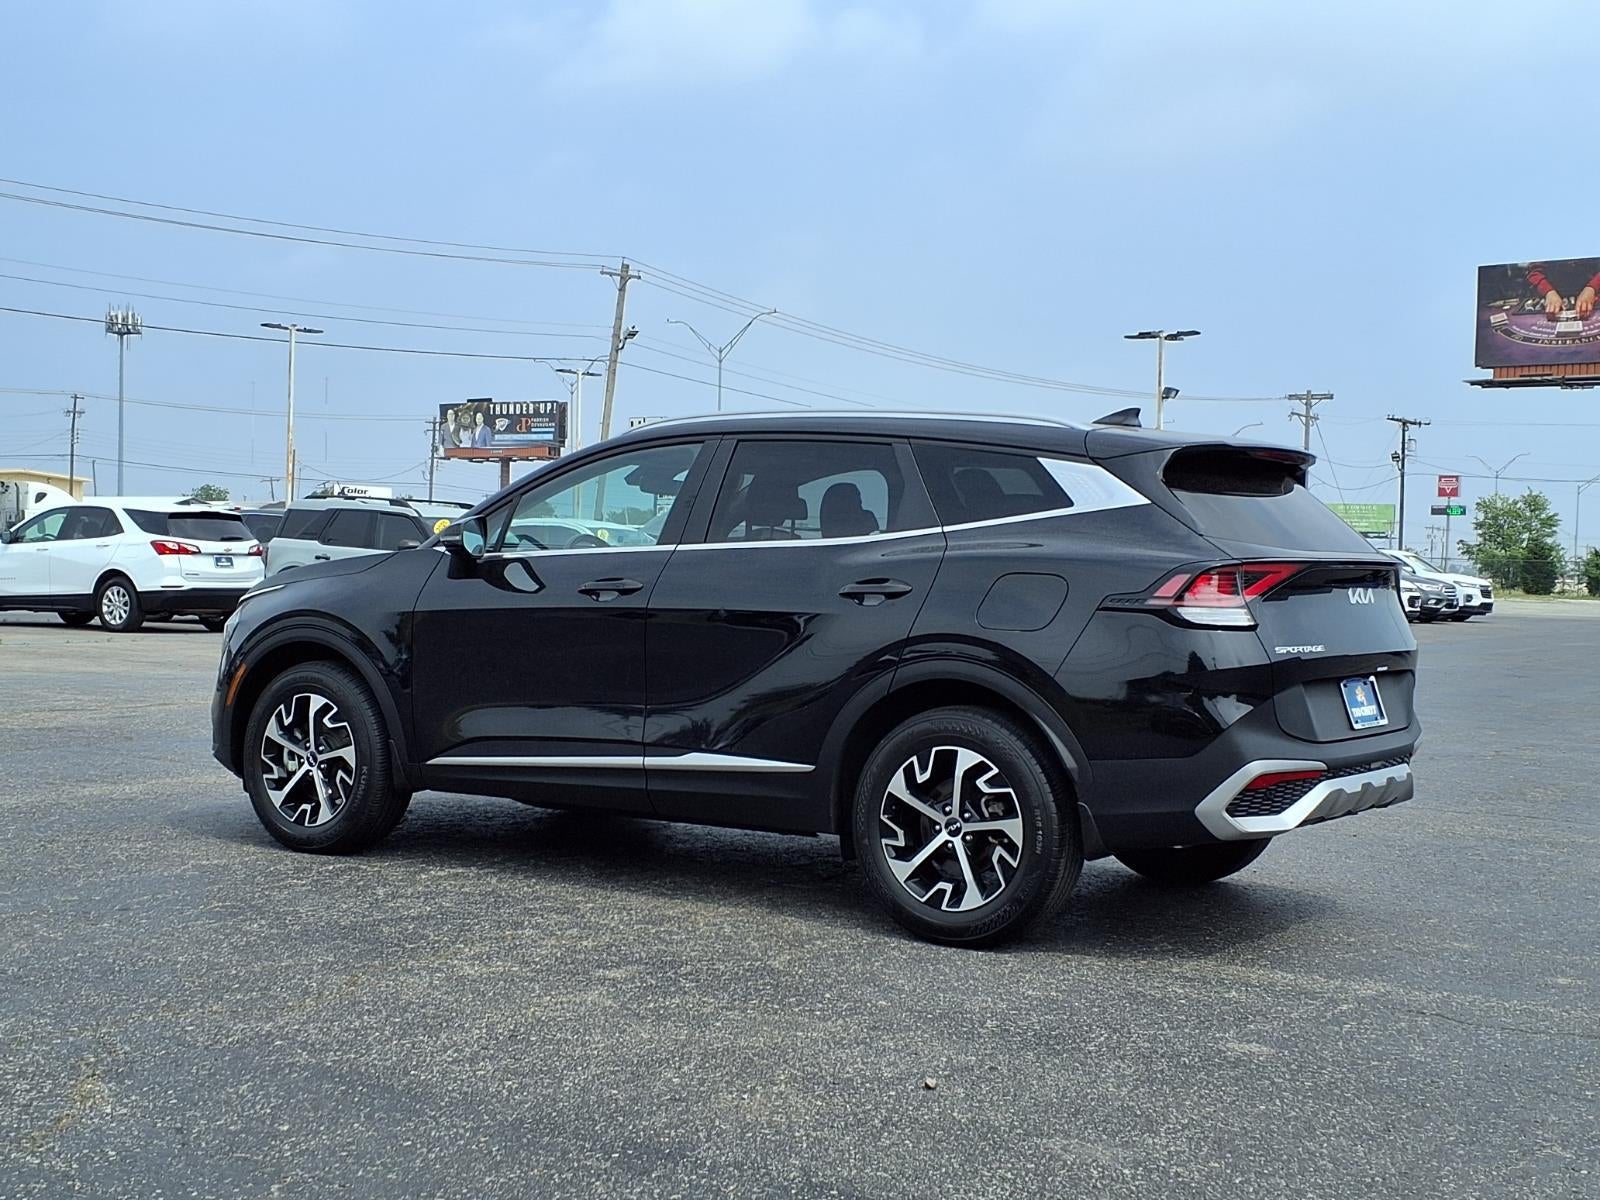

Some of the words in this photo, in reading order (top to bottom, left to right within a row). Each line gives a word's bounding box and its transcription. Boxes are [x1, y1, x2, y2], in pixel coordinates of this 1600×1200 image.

[489, 403, 534, 415] THUNDER
[539, 402, 557, 414] UP!
[1347, 587, 1375, 604] KIA
[1274, 644, 1326, 654] SPORTAGE
